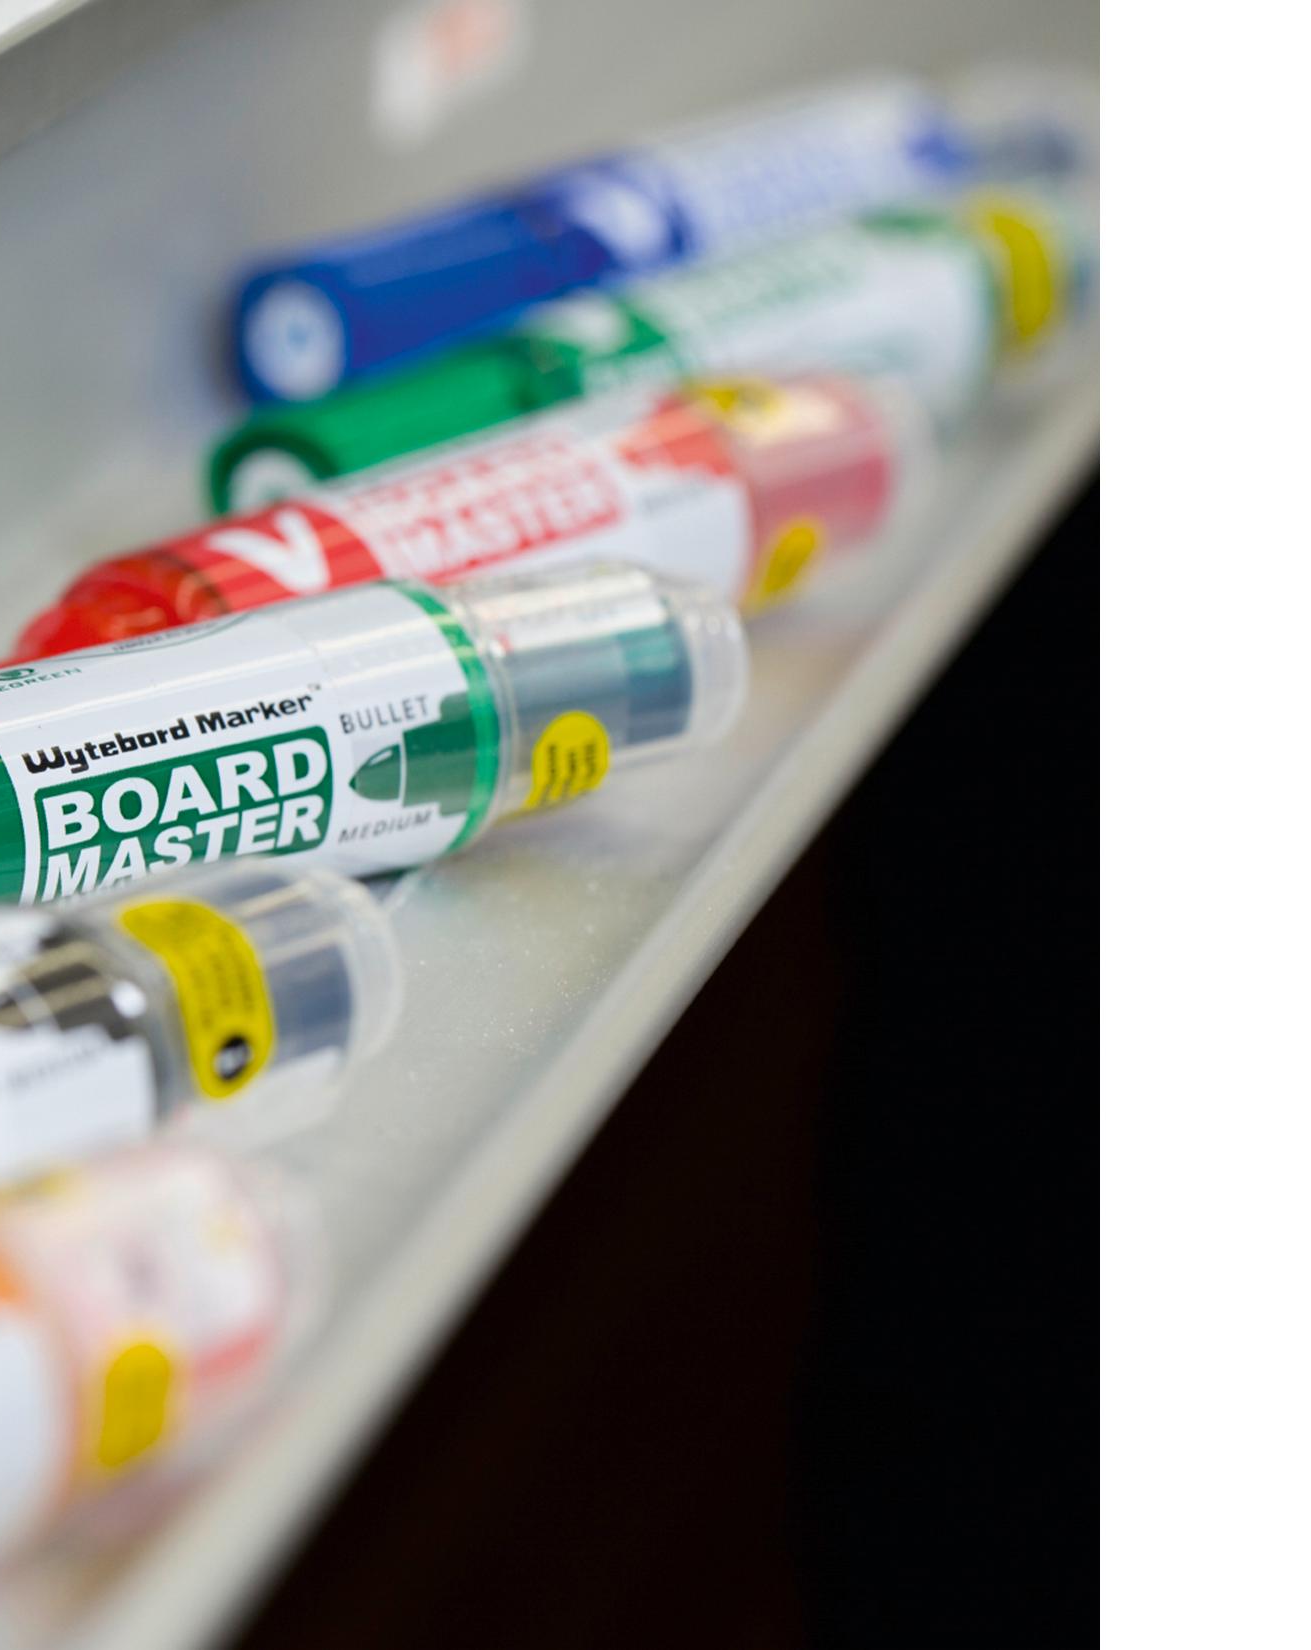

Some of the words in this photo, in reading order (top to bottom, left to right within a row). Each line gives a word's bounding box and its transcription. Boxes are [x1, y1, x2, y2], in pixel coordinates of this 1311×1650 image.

[339, 694, 429, 735] BULLET
[21, 717, 191, 775] Wytebord
[42, 737, 329, 851] BOARD
[41, 794, 326, 903] MASTER
[337, 810, 433, 844] MEDIUM
